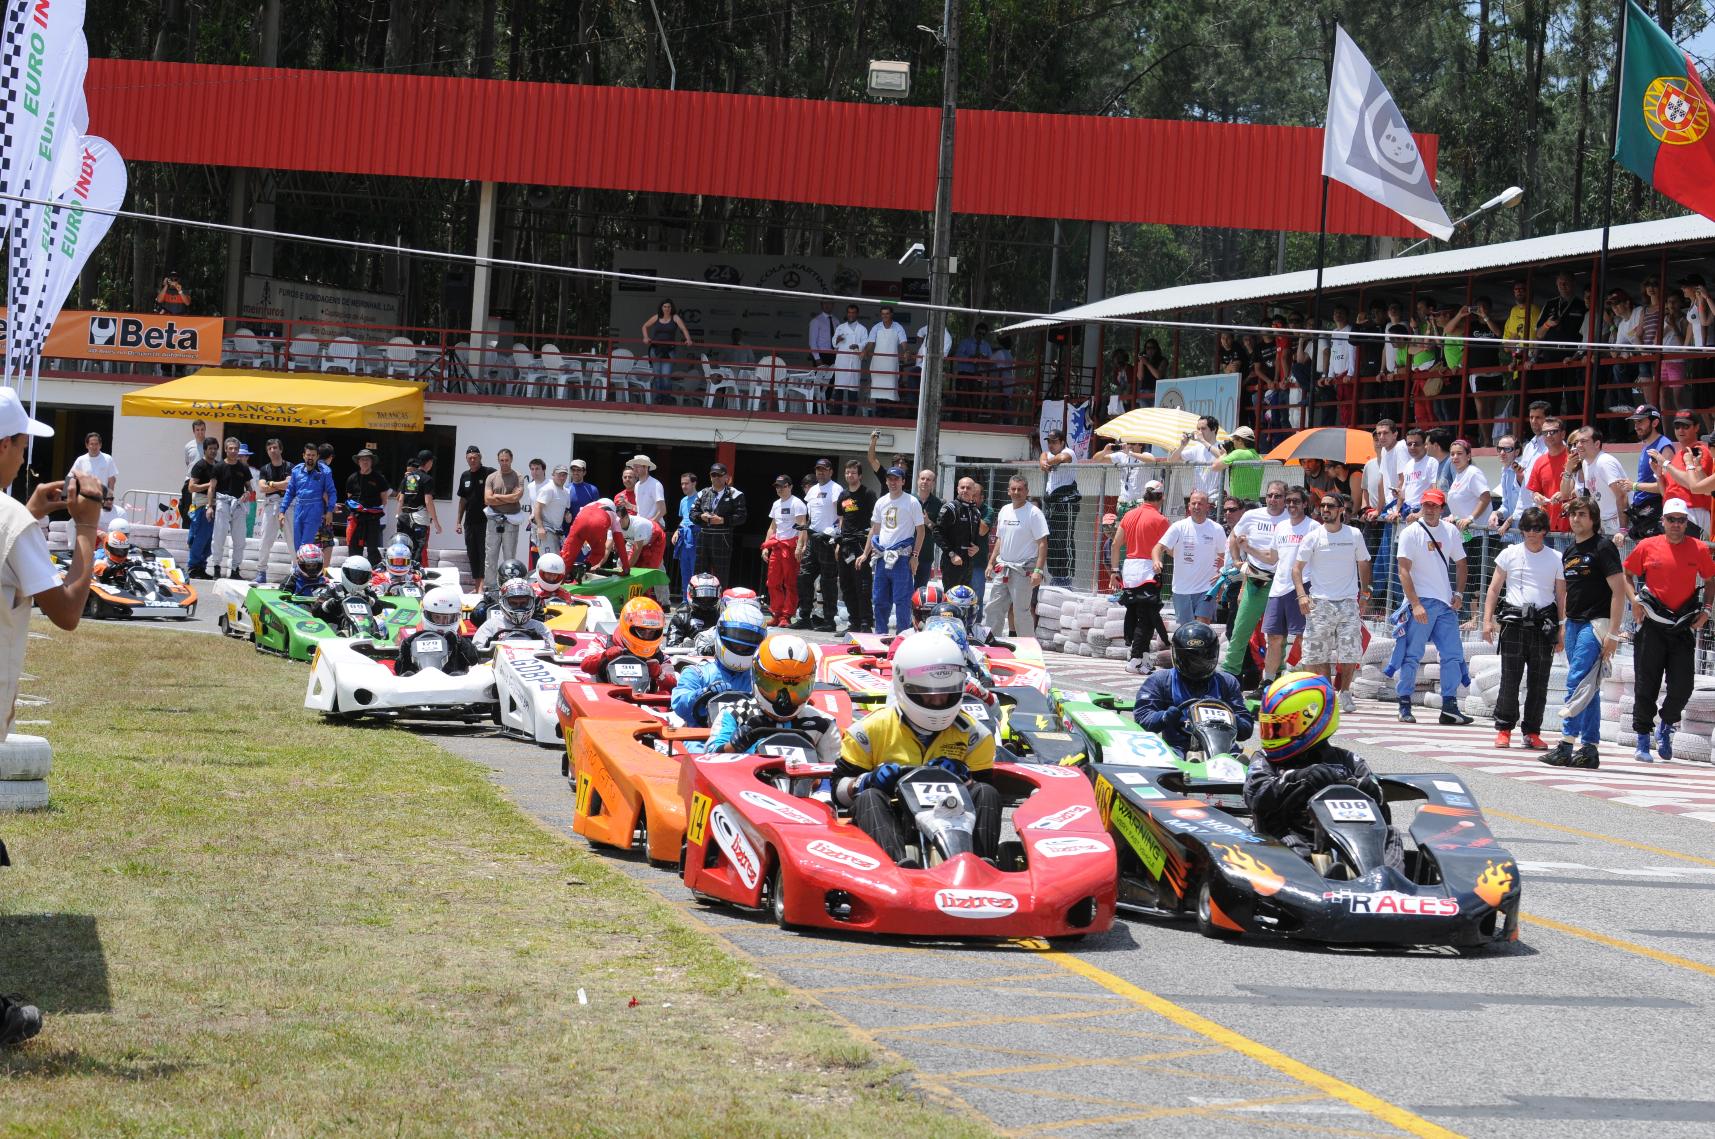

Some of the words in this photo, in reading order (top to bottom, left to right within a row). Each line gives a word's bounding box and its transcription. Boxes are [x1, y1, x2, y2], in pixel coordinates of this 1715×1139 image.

[24, 33, 45, 117] EURO
[61, 200, 85, 260] EURO
[74, 147, 97, 200] INDY
[119, 318, 199, 351] Beta
[1204, 709, 1226, 717] 115
[773, 746, 797, 756] 17
[576, 774, 590, 812] 17
[919, 783, 953, 794] 74
[690, 795, 707, 840] 74
[1118, 799, 1161, 861] WARNING
[1351, 894, 1458, 915] RACES
